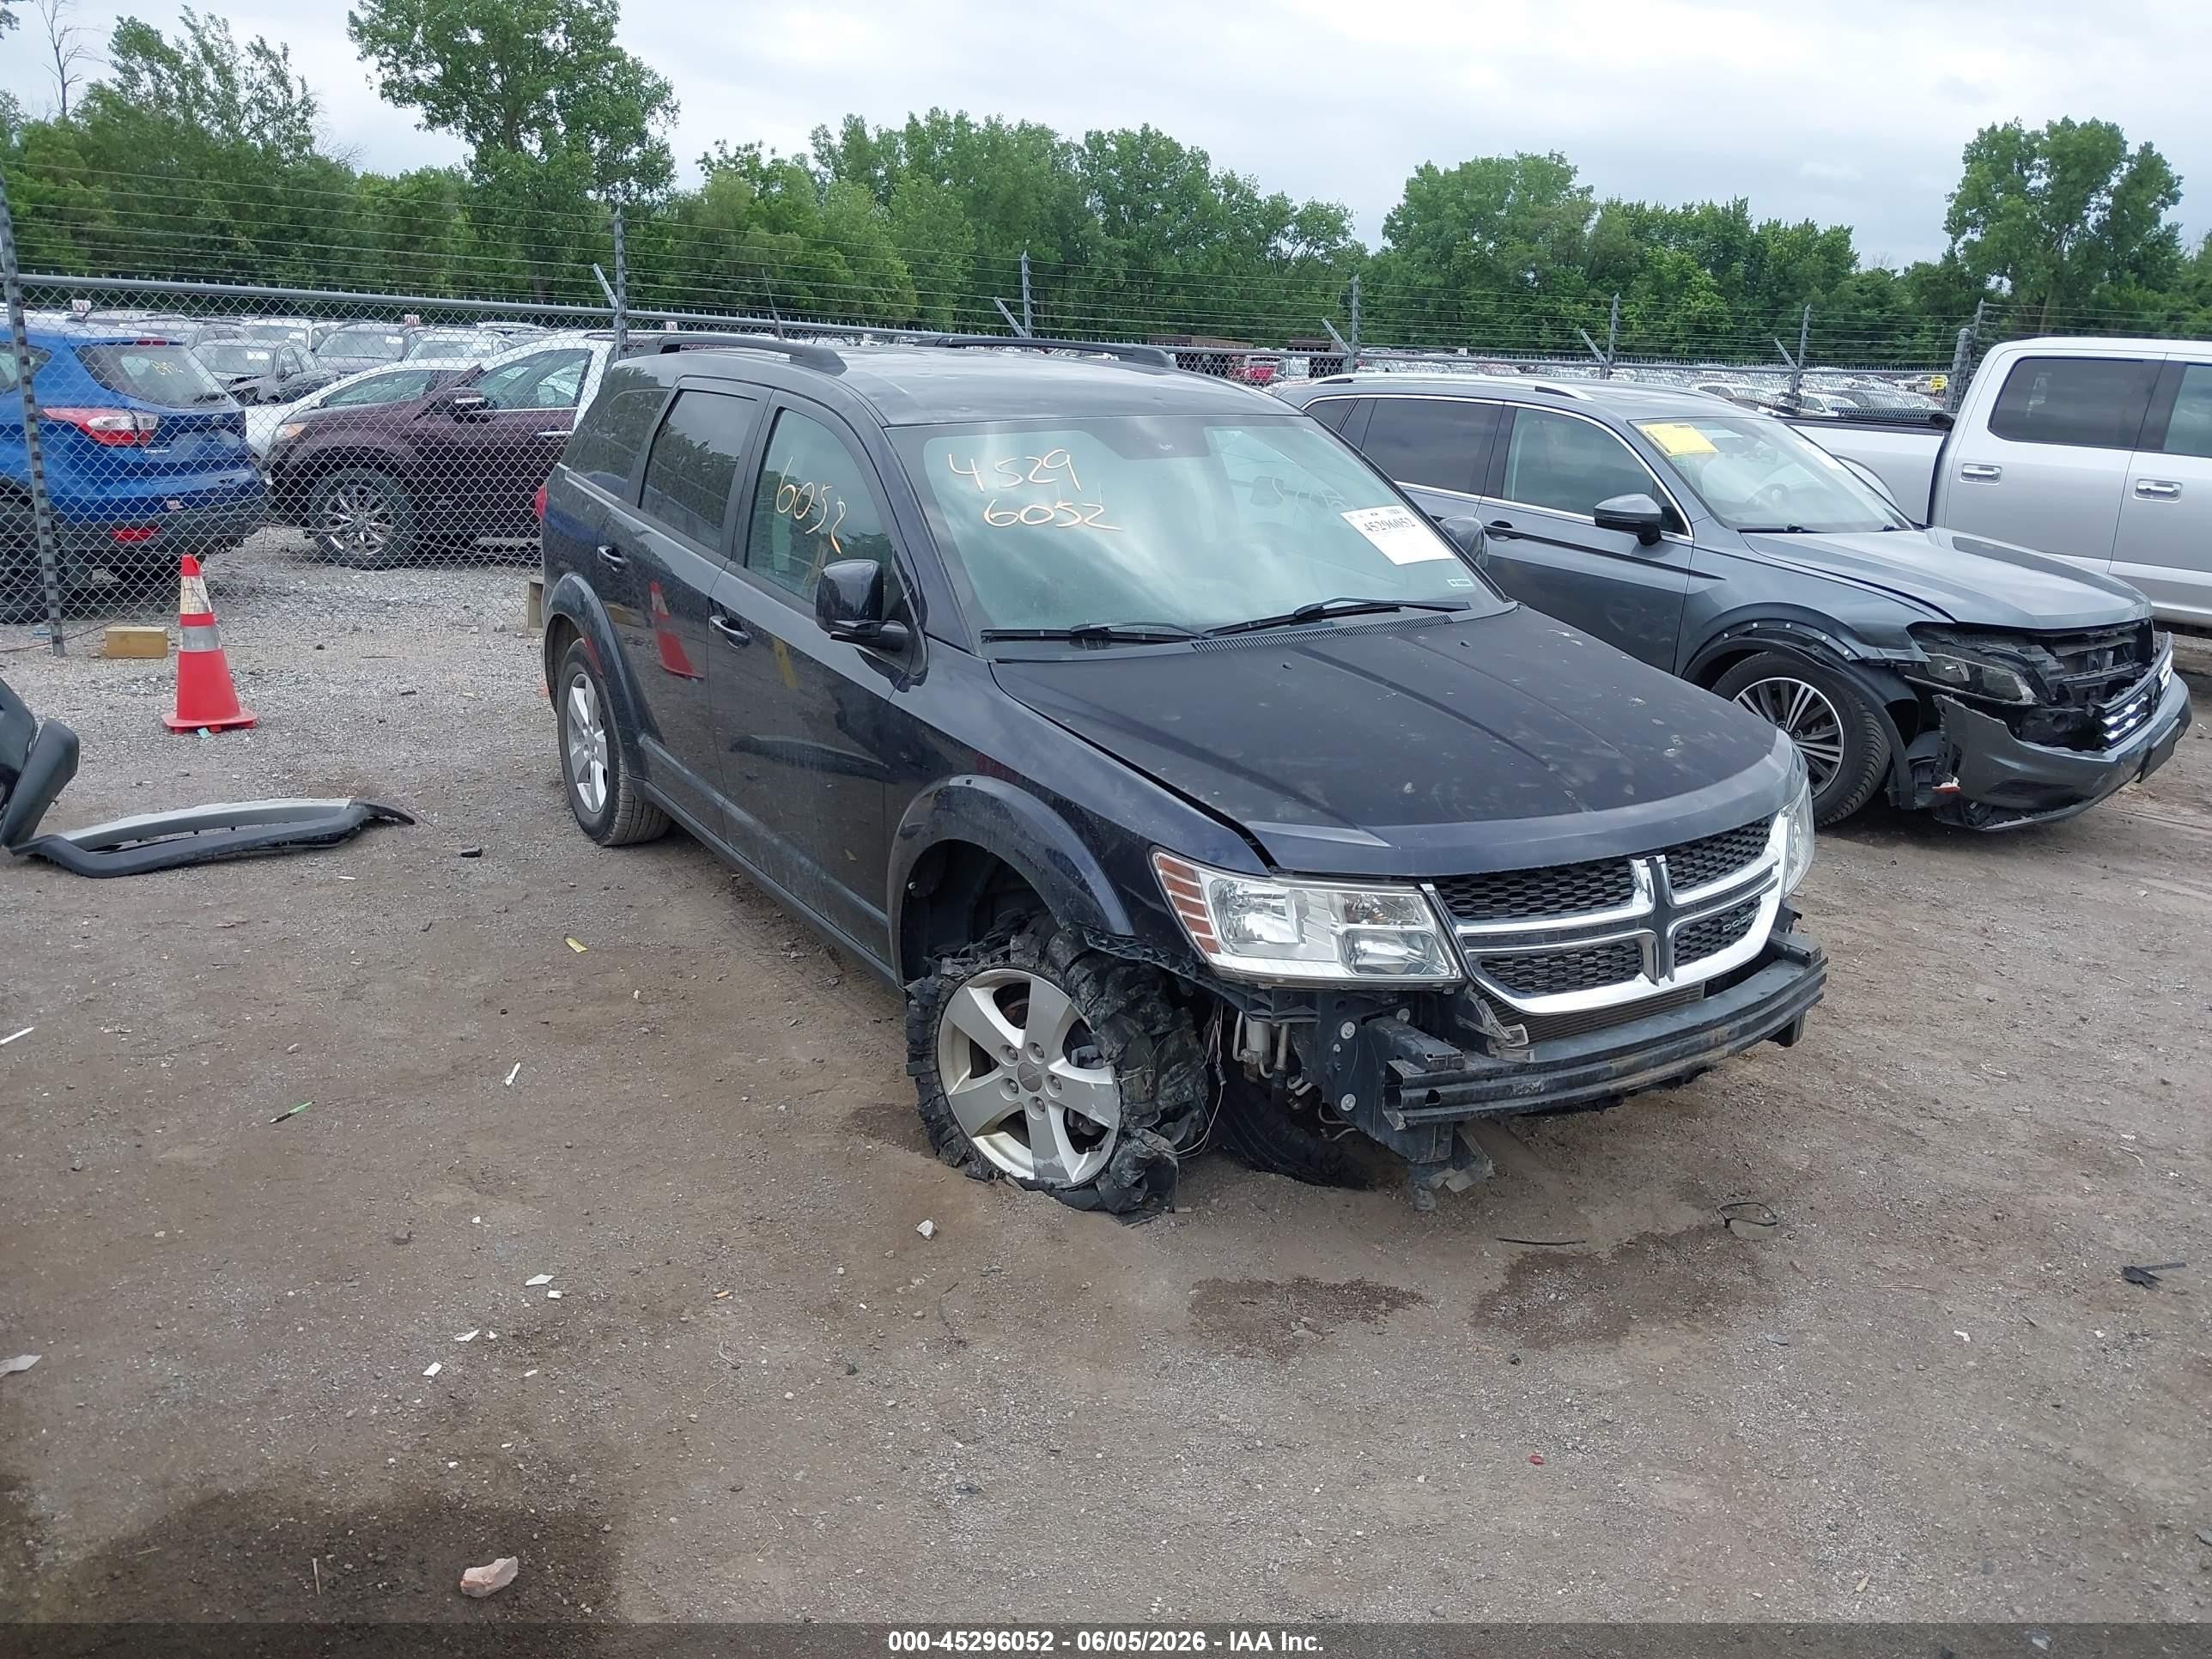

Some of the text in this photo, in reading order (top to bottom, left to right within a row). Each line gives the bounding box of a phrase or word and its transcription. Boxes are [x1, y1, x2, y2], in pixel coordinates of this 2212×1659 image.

[948, 449, 1082, 493] 4529
[776, 456, 847, 555] 6052
[983, 498, 1124, 532] 6052
